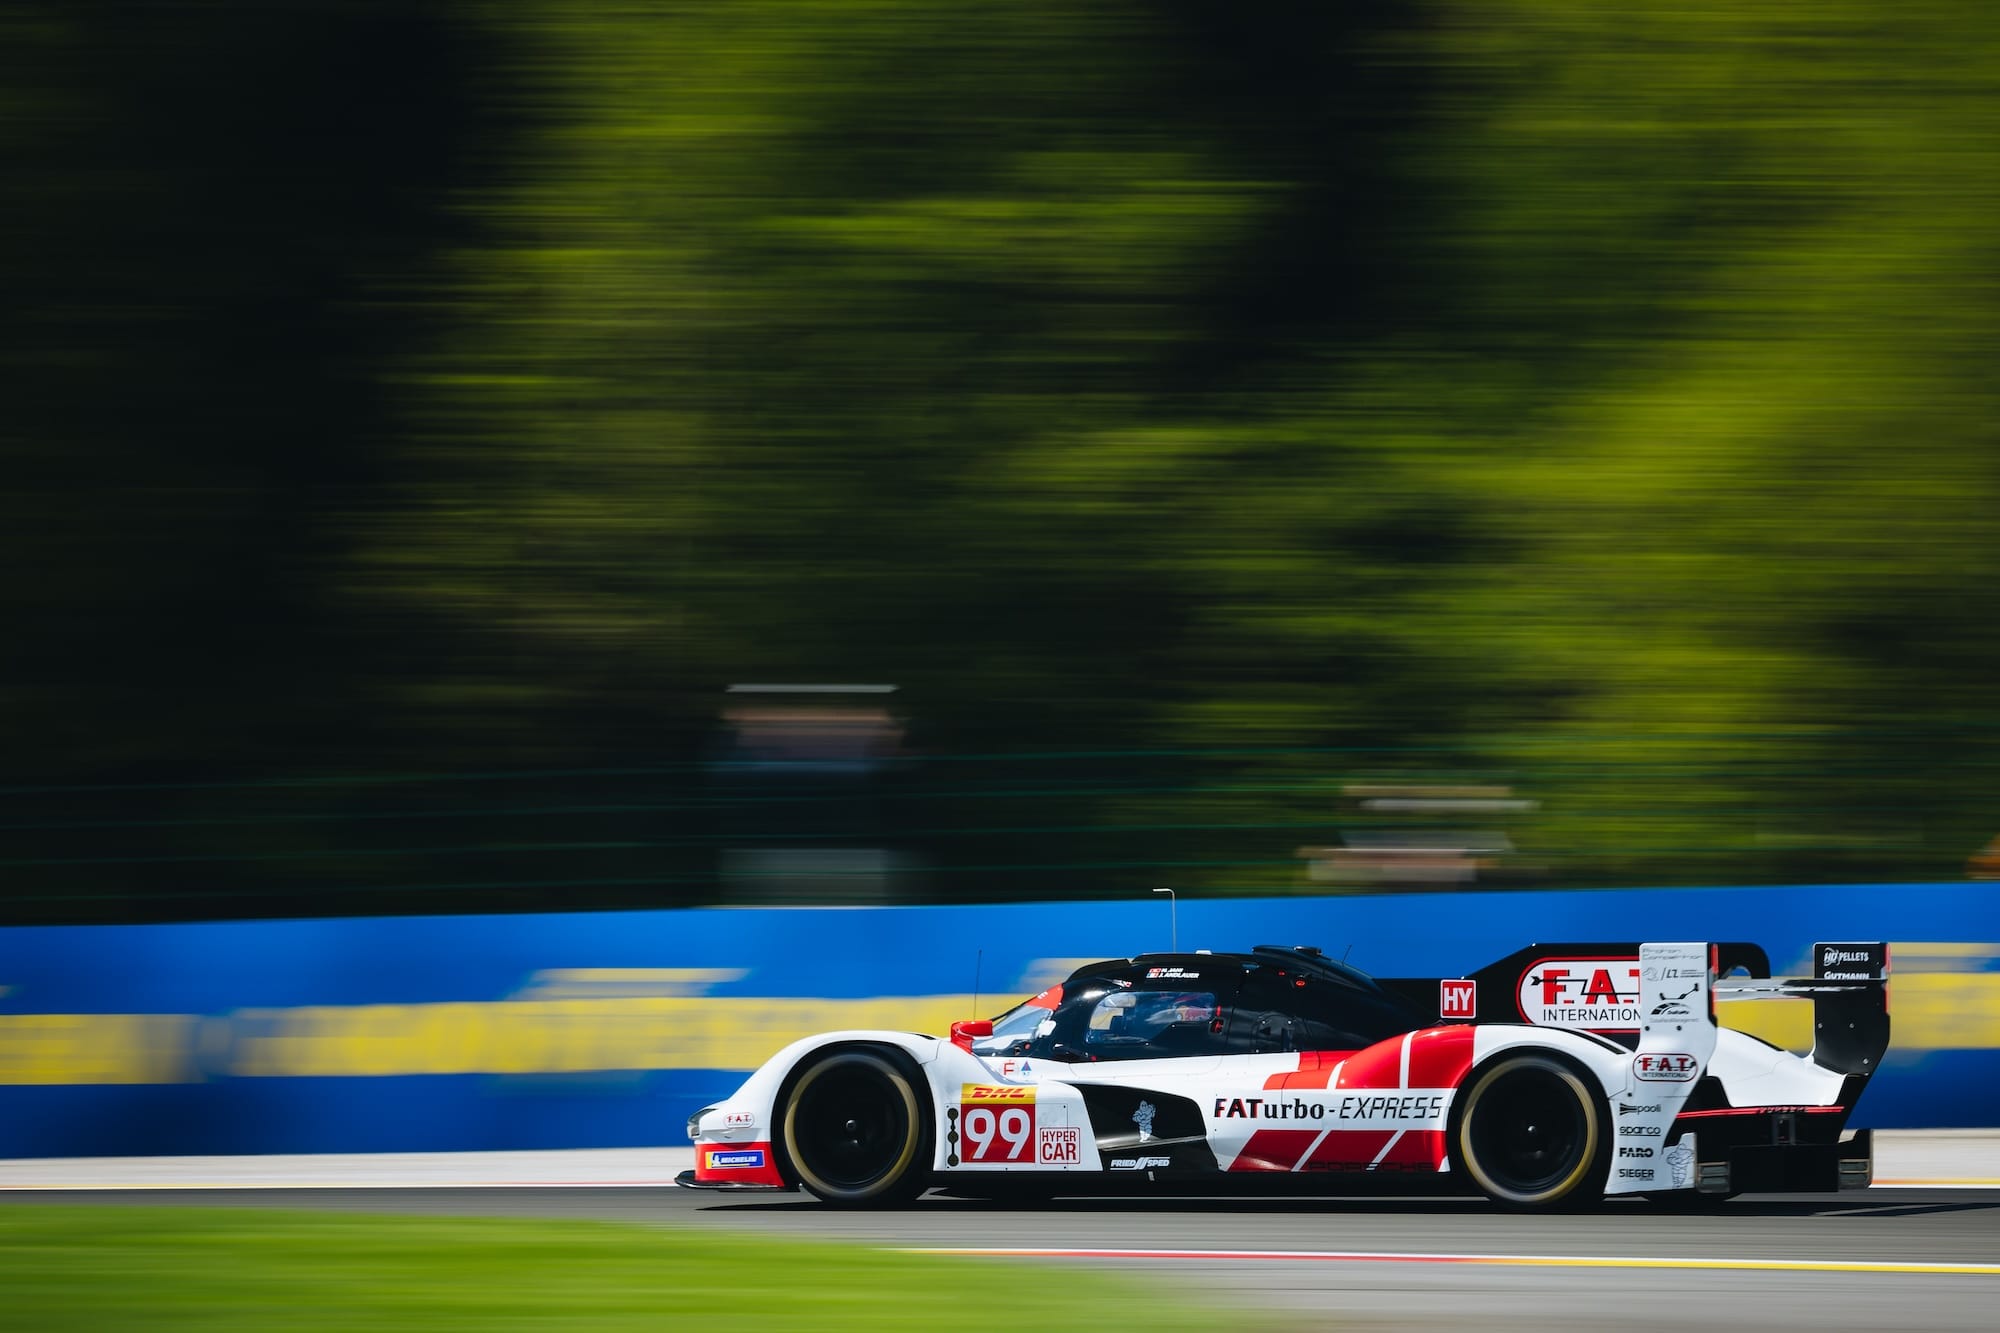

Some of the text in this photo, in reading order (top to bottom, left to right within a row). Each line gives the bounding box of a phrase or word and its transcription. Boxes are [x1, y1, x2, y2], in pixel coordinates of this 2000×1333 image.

[1839, 951, 1870, 962] PELLETS
[1824, 971, 1870, 980] GUTMANN
[1444, 987, 1473, 1012] HY
[971, 1086, 1027, 1098] DHL
[1637, 1103, 1661, 1116] paoli
[964, 1108, 1031, 1160] 99
[1041, 1130, 1077, 1142] HYPER
[1619, 1125, 1661, 1136] sparco
[1041, 1142, 1077, 1161] CAR
[1619, 1147, 1654, 1158] FARO
[1618, 1168, 1655, 1178] SIEGER
